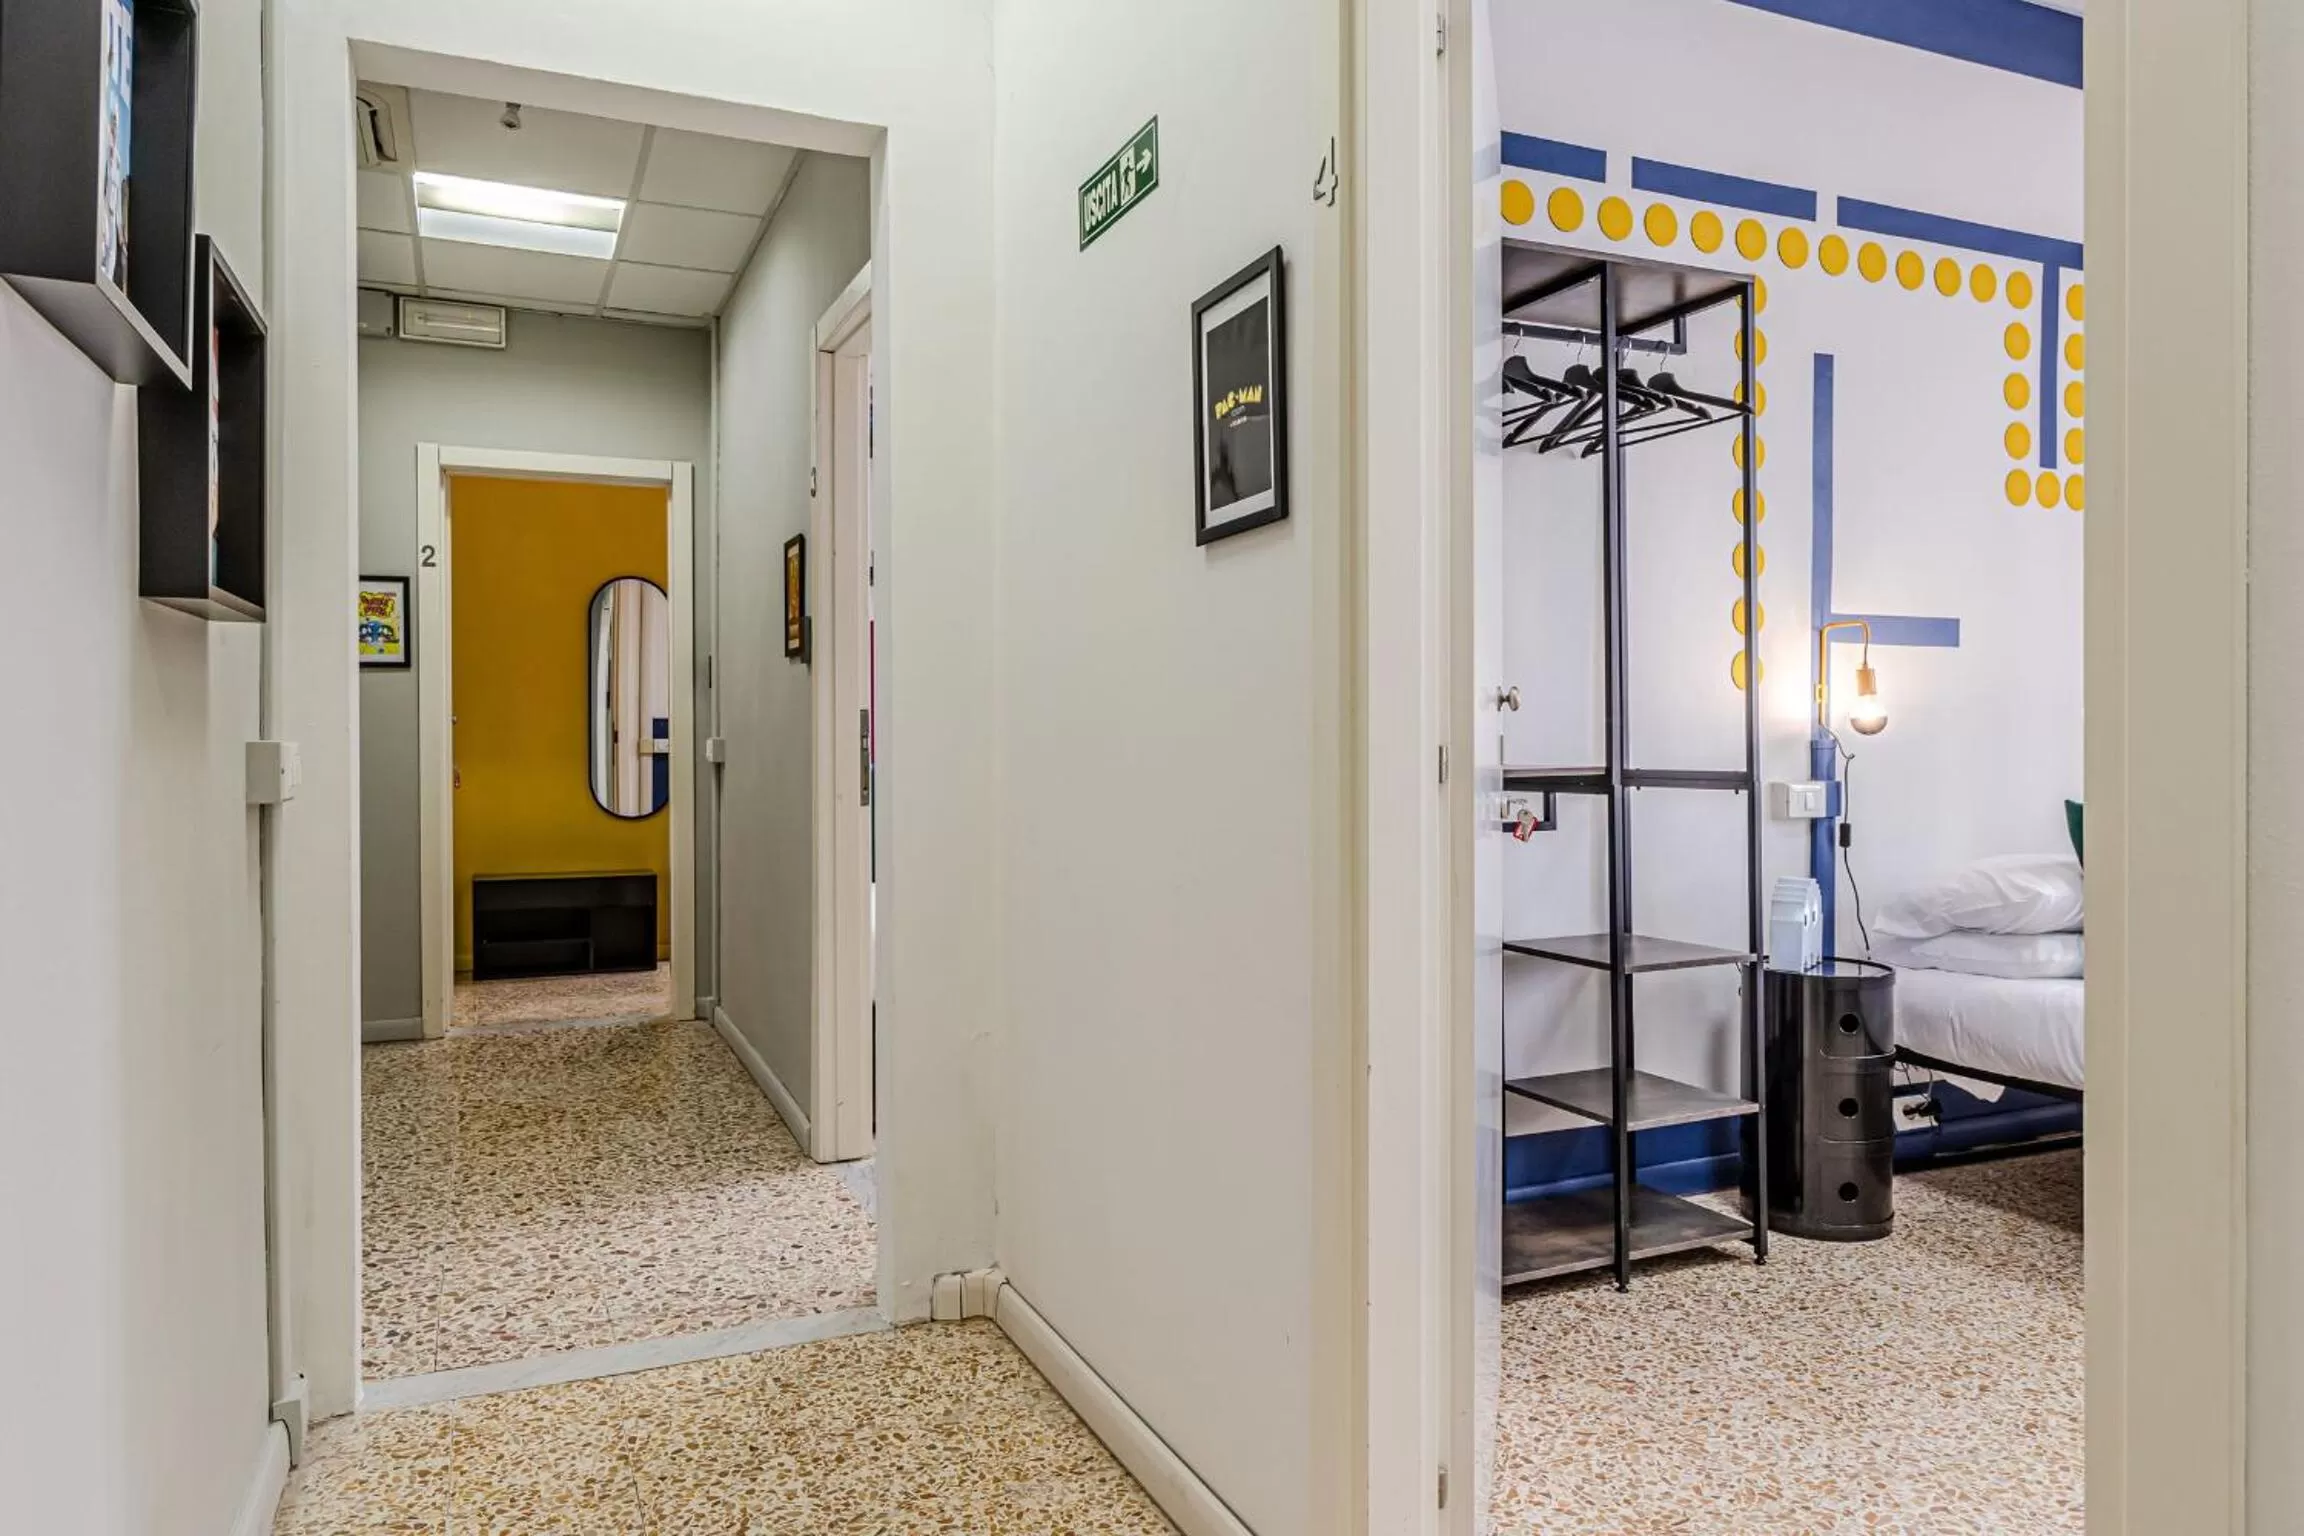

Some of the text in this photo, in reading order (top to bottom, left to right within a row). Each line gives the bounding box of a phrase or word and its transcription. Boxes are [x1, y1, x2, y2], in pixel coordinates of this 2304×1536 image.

[1312, 136, 1339, 208] 4
[1084, 169, 1119, 232] USCITA
[1214, 384, 1263, 421] PAC-MAN
[420, 544, 437, 568] 2
